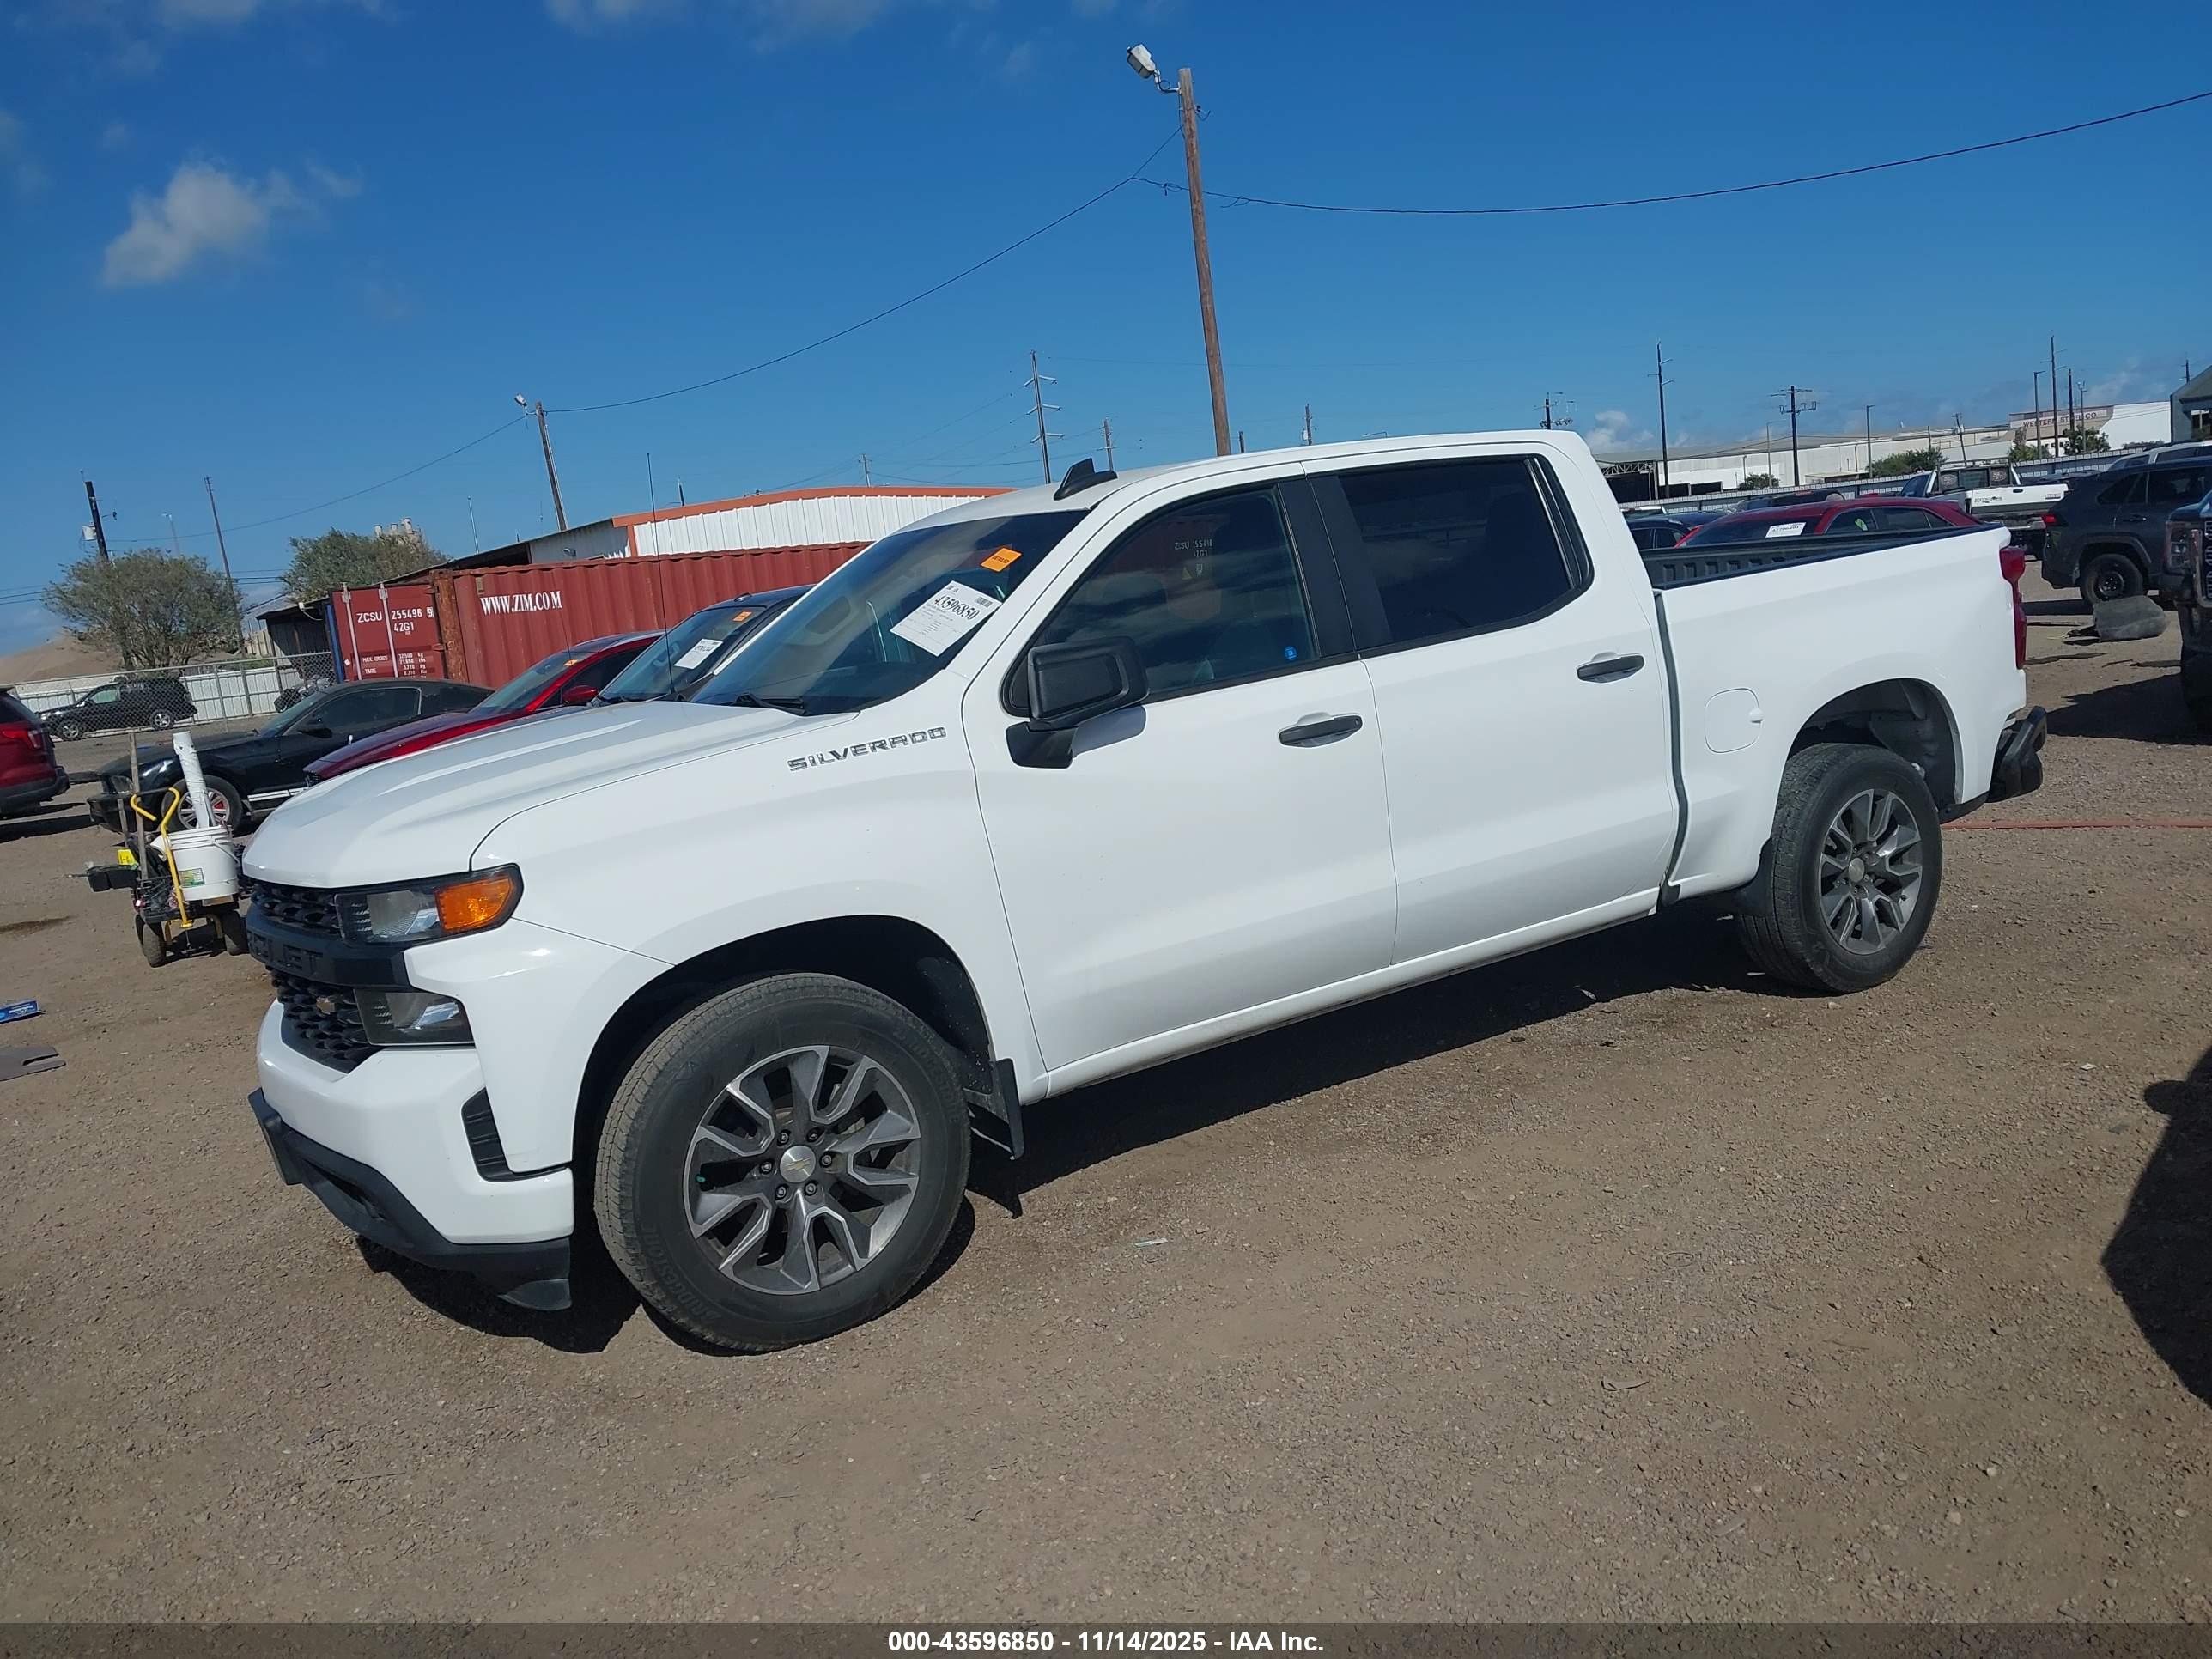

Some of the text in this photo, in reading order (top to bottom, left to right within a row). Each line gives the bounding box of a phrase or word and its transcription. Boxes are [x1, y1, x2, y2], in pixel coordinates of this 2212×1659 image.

[2060, 413, 2083, 423] STEL
[934, 595, 980, 620] 43596850
[356, 611, 383, 623] ZCSU
[391, 608, 422, 620] 255496
[393, 622, 415, 632] 42G1
[787, 726, 946, 771] SILVERADO
